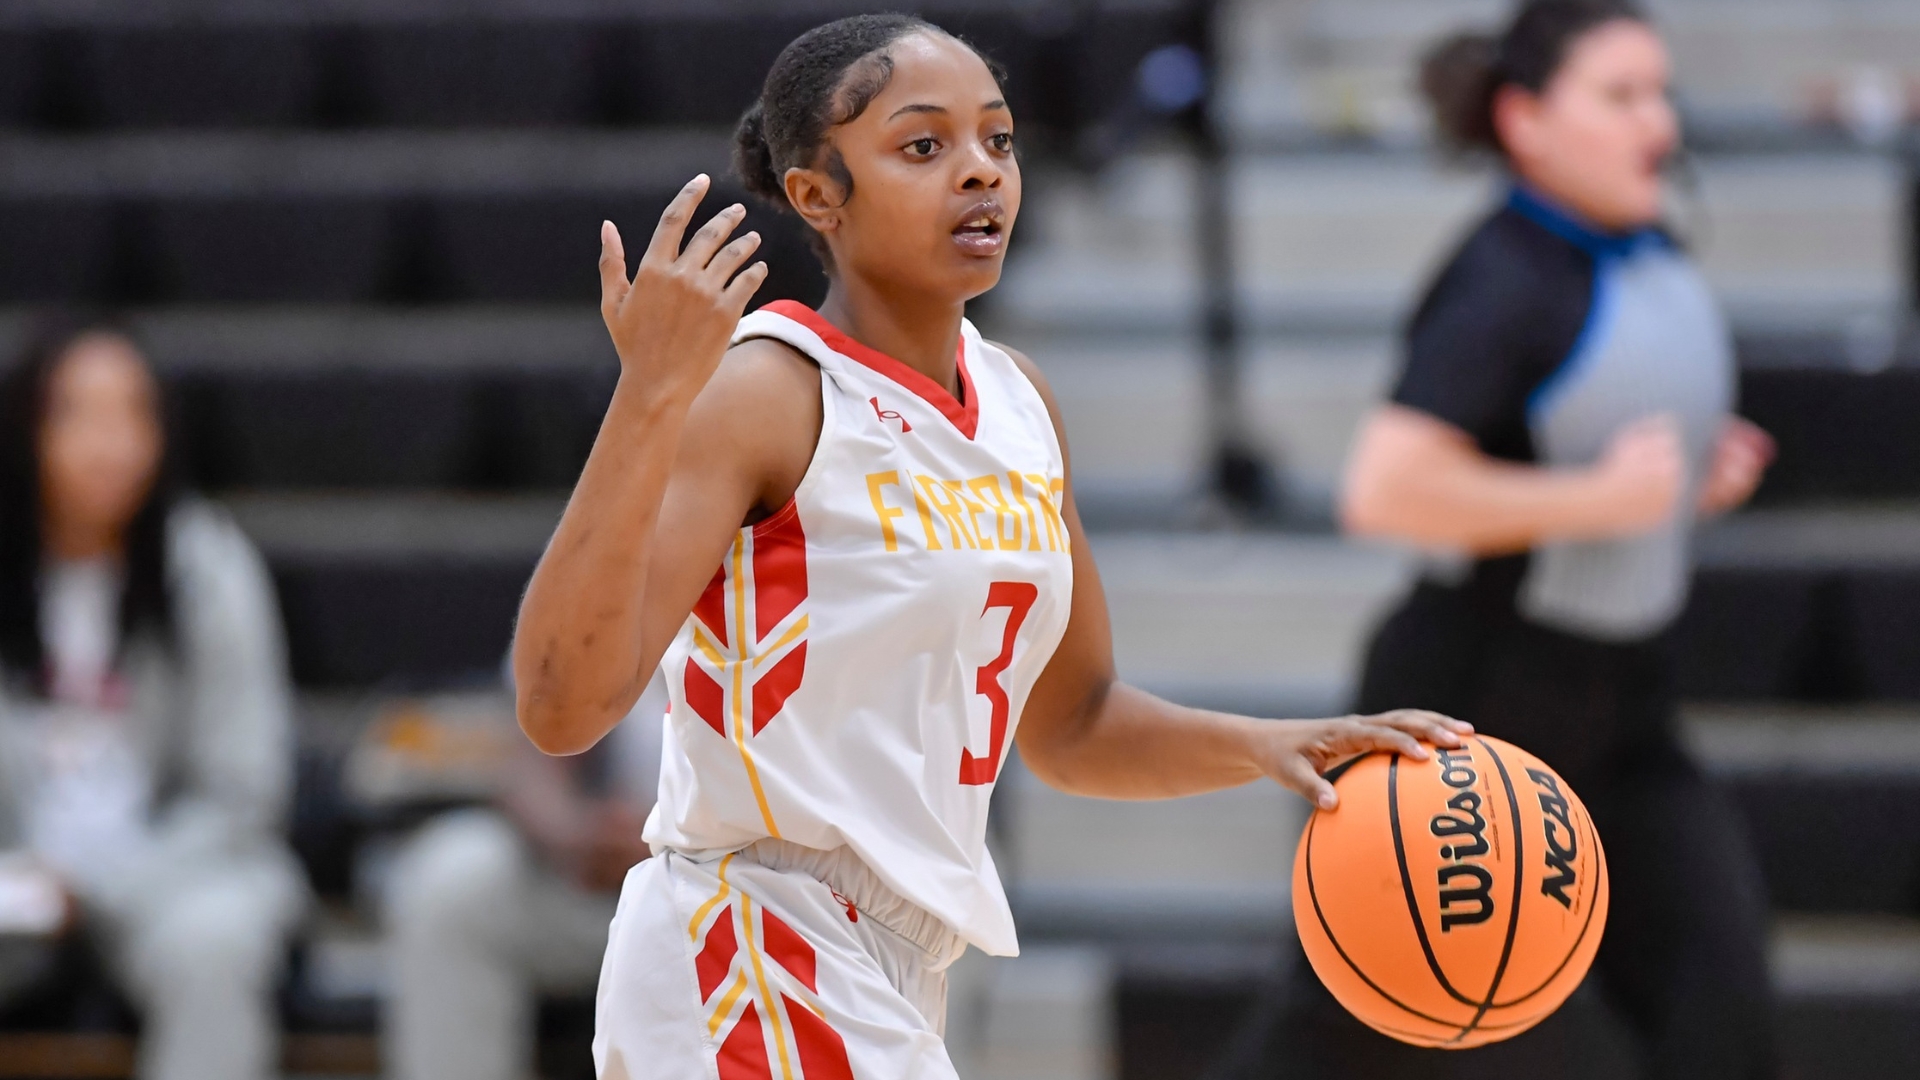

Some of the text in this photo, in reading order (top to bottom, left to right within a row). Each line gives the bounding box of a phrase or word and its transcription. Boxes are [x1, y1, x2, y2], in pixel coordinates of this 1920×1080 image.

[959, 581, 1038, 786] 3
[1429, 743, 1496, 934] Wilson
[1524, 766, 1578, 912] NCAA
